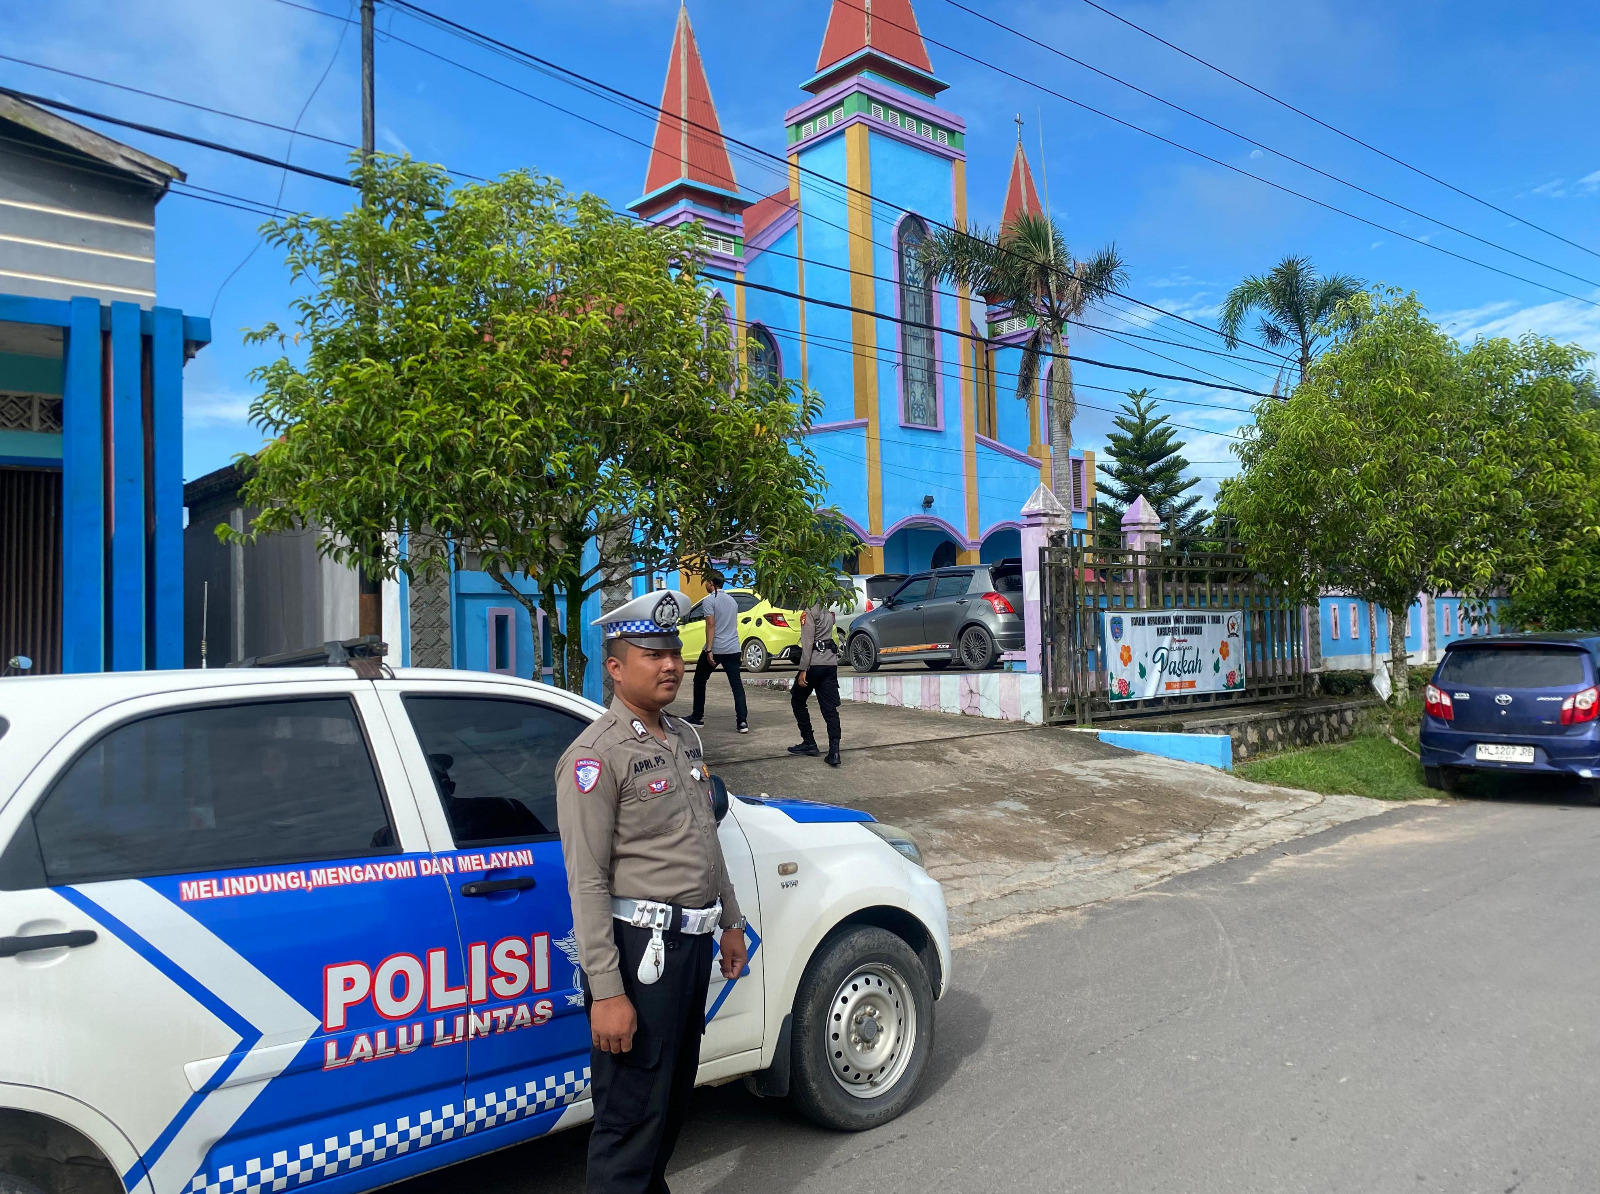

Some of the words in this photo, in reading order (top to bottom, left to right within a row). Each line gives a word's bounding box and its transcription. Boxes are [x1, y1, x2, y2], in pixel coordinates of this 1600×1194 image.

[1152, 646, 1203, 678] Paskah
[420, 858, 455, 876] DAN
[457, 850, 534, 873] MELAYANI
[324, 932, 550, 1032] POLISI
[322, 1026, 424, 1071] LALU
[432, 1000, 553, 1048] LINTAS
